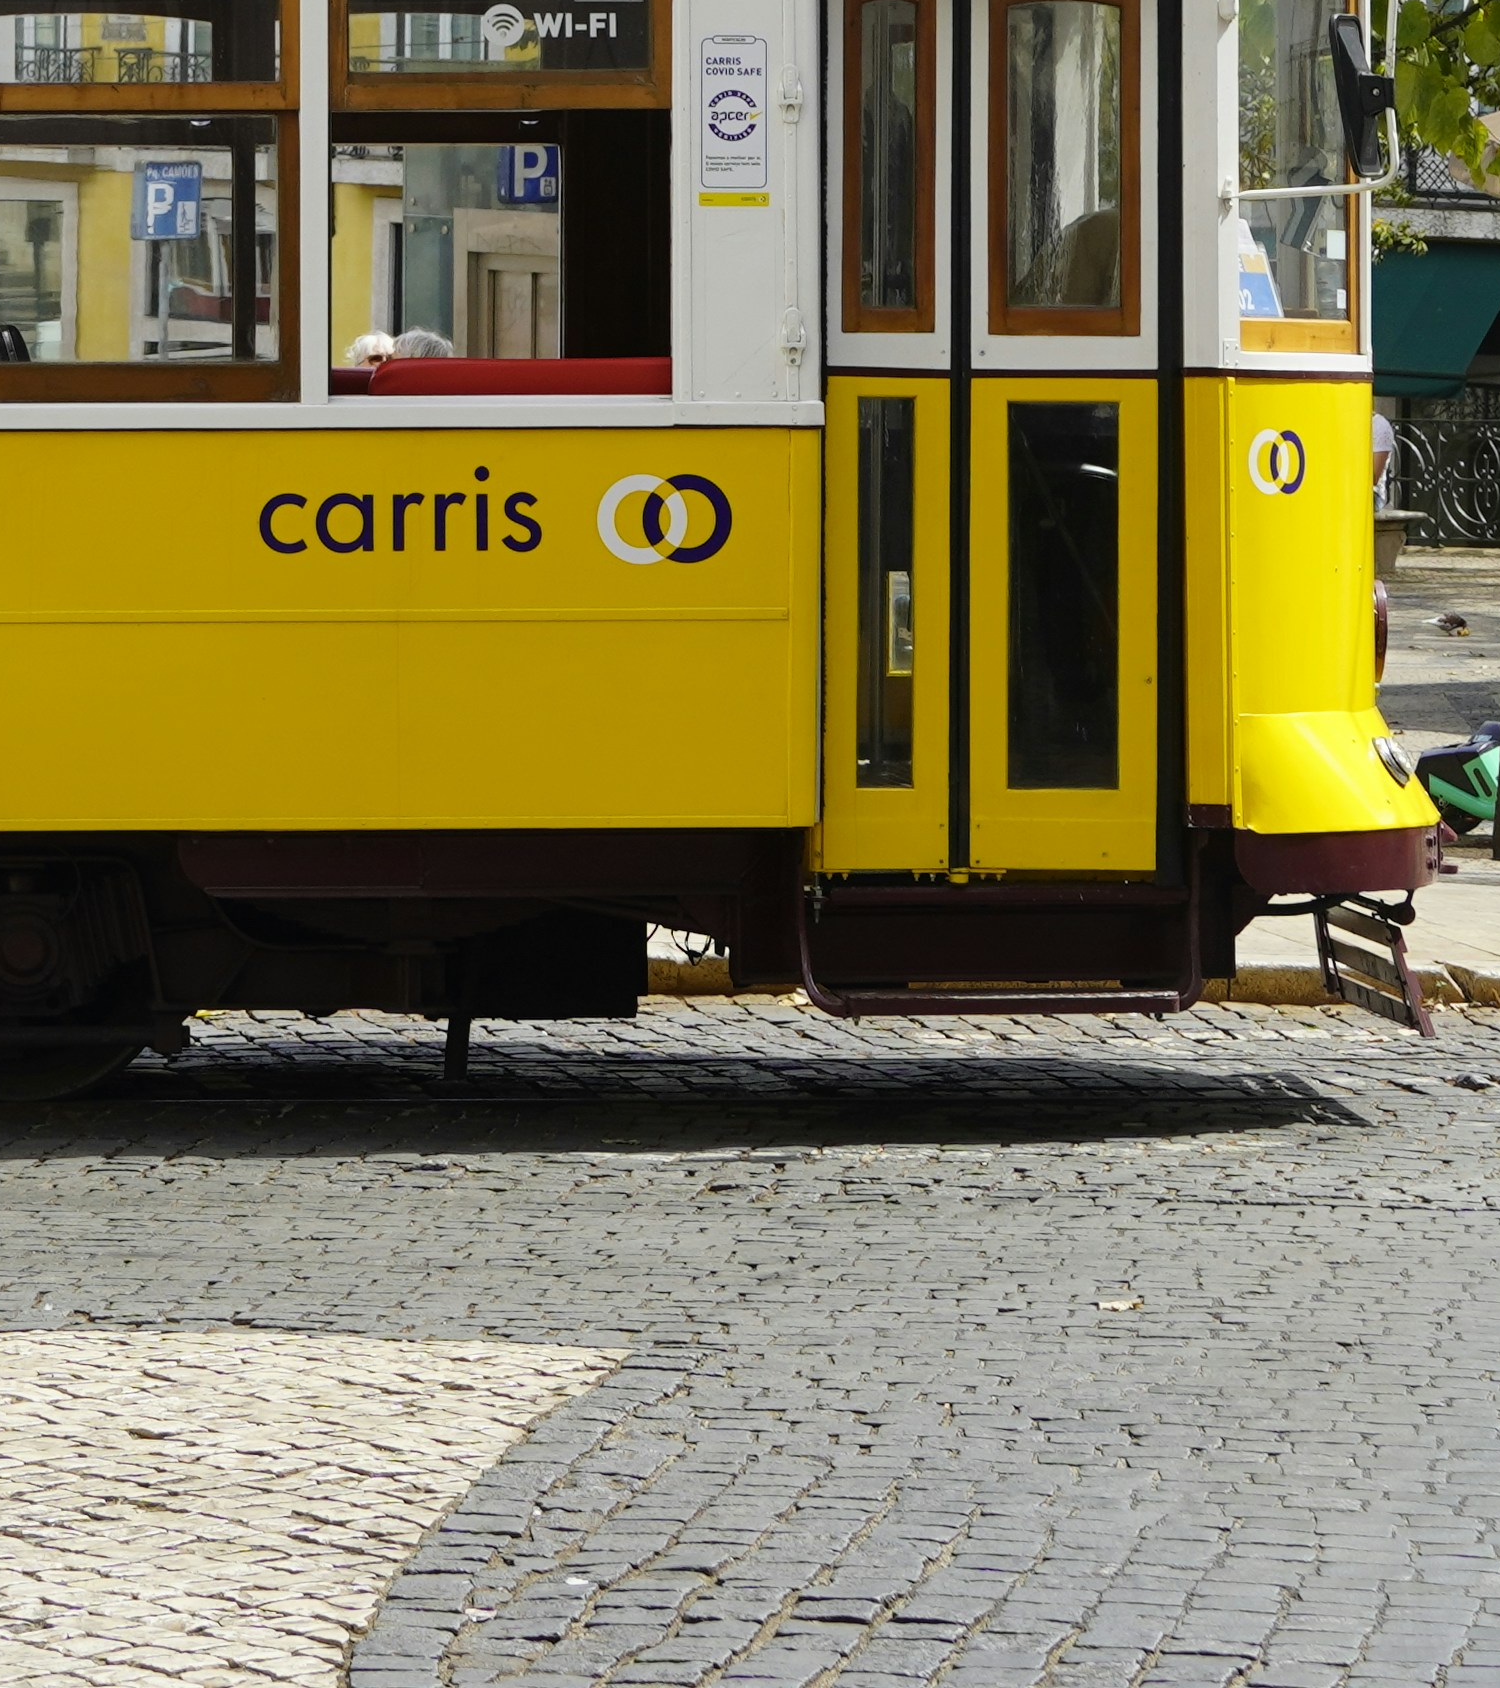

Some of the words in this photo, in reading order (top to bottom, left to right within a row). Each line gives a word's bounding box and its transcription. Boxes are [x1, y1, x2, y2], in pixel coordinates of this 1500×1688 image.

[533, 12, 617, 38] WI-FI
[705, 56, 742, 66] CARRIS
[705, 67, 735, 76] COVID
[736, 67, 763, 77] SAFE
[710, 111, 749, 124] apcer
[514, 145, 549, 198] P
[147, 183, 175, 234] P
[260, 466, 543, 554] carris
